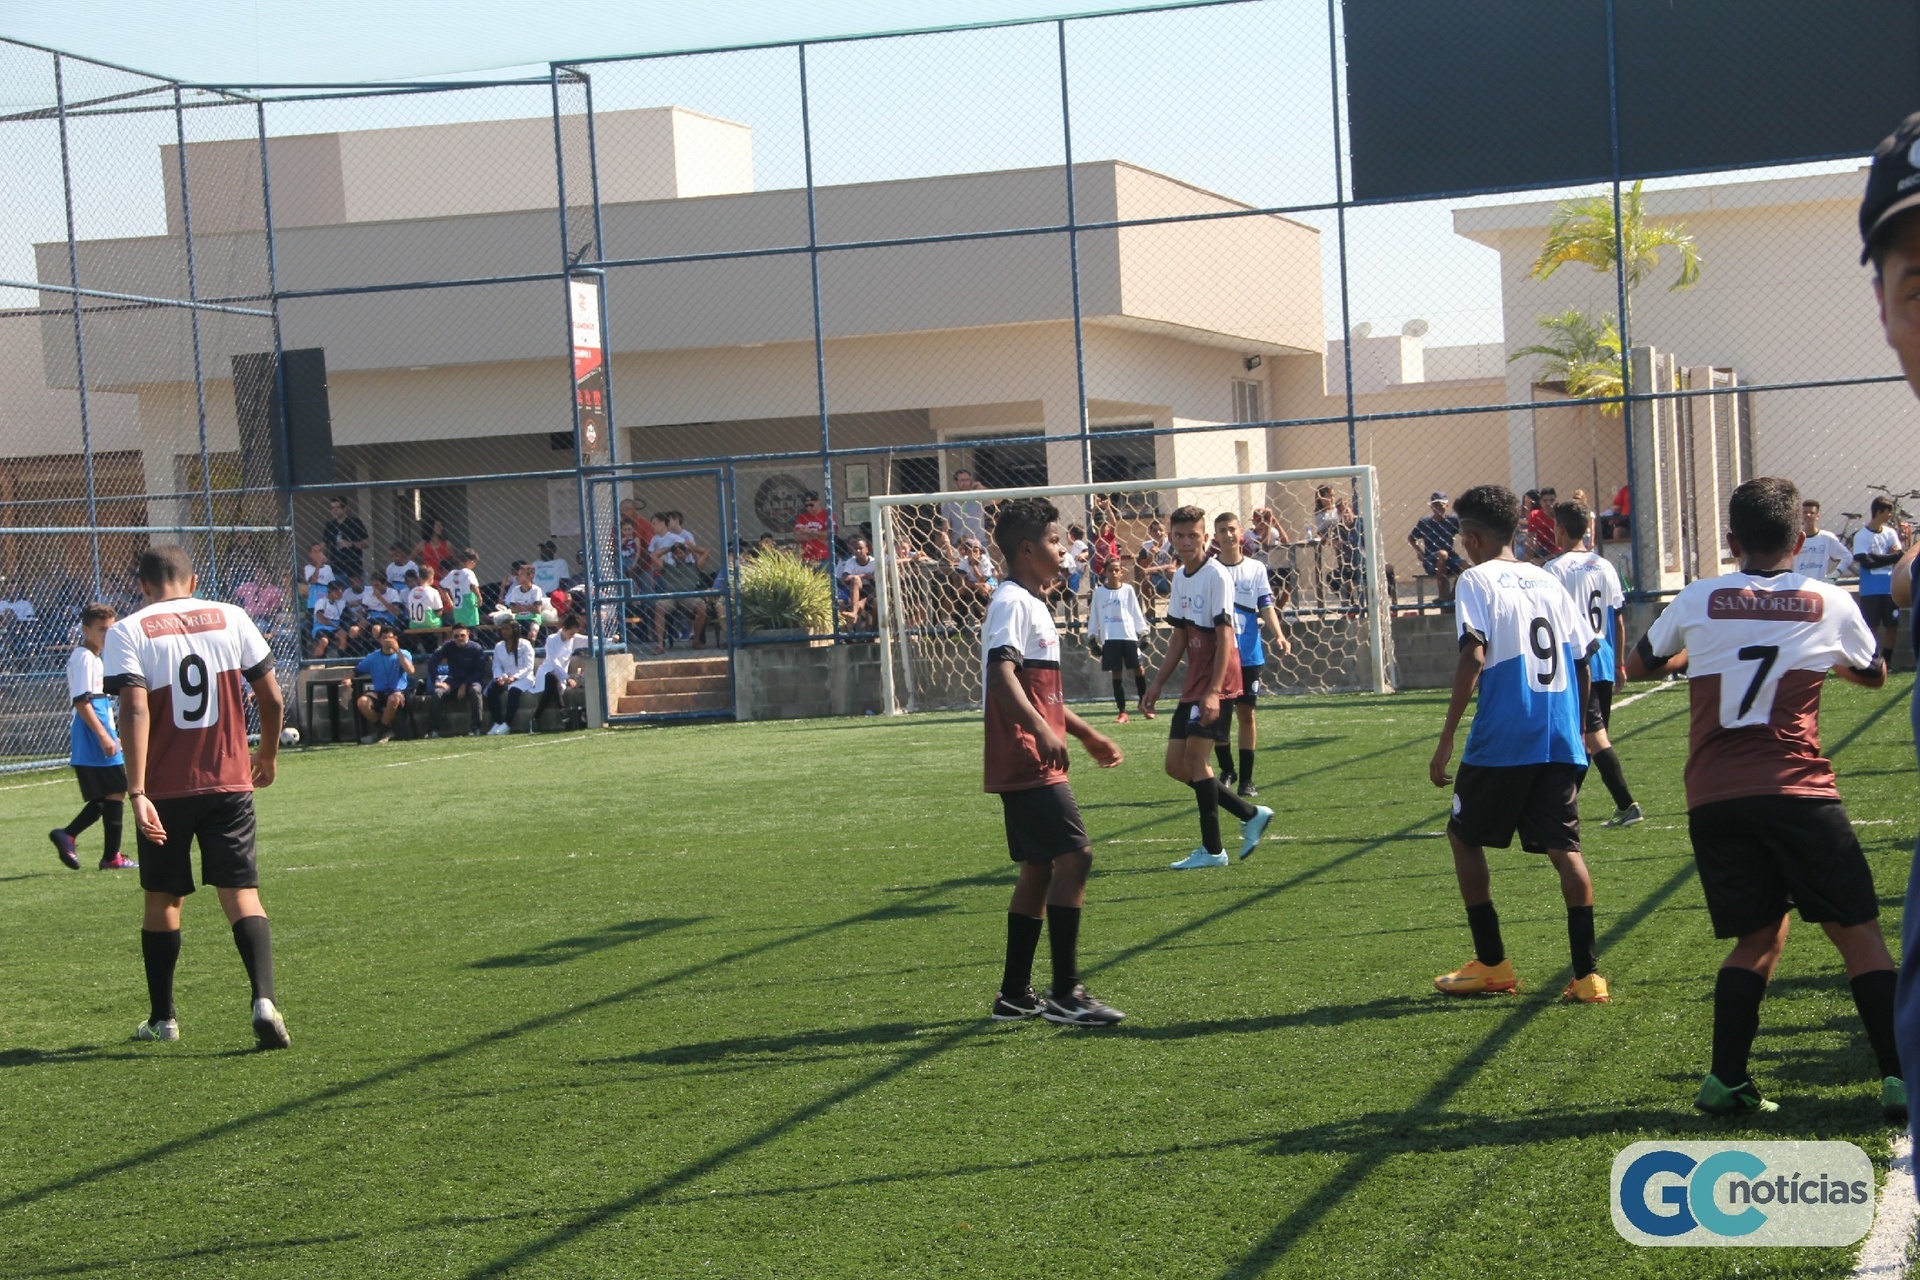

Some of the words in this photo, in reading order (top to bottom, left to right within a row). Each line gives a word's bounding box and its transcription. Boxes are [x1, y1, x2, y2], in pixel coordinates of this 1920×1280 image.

[455, 588, 461, 607] 5
[1713, 594, 1819, 614] SANTORELI
[411, 602, 424, 622] 10
[146, 613, 222, 633] SANTORELI
[1529, 616, 1557, 685] 9
[179, 654, 209, 722] 9
[1737, 645, 1779, 720] 7
